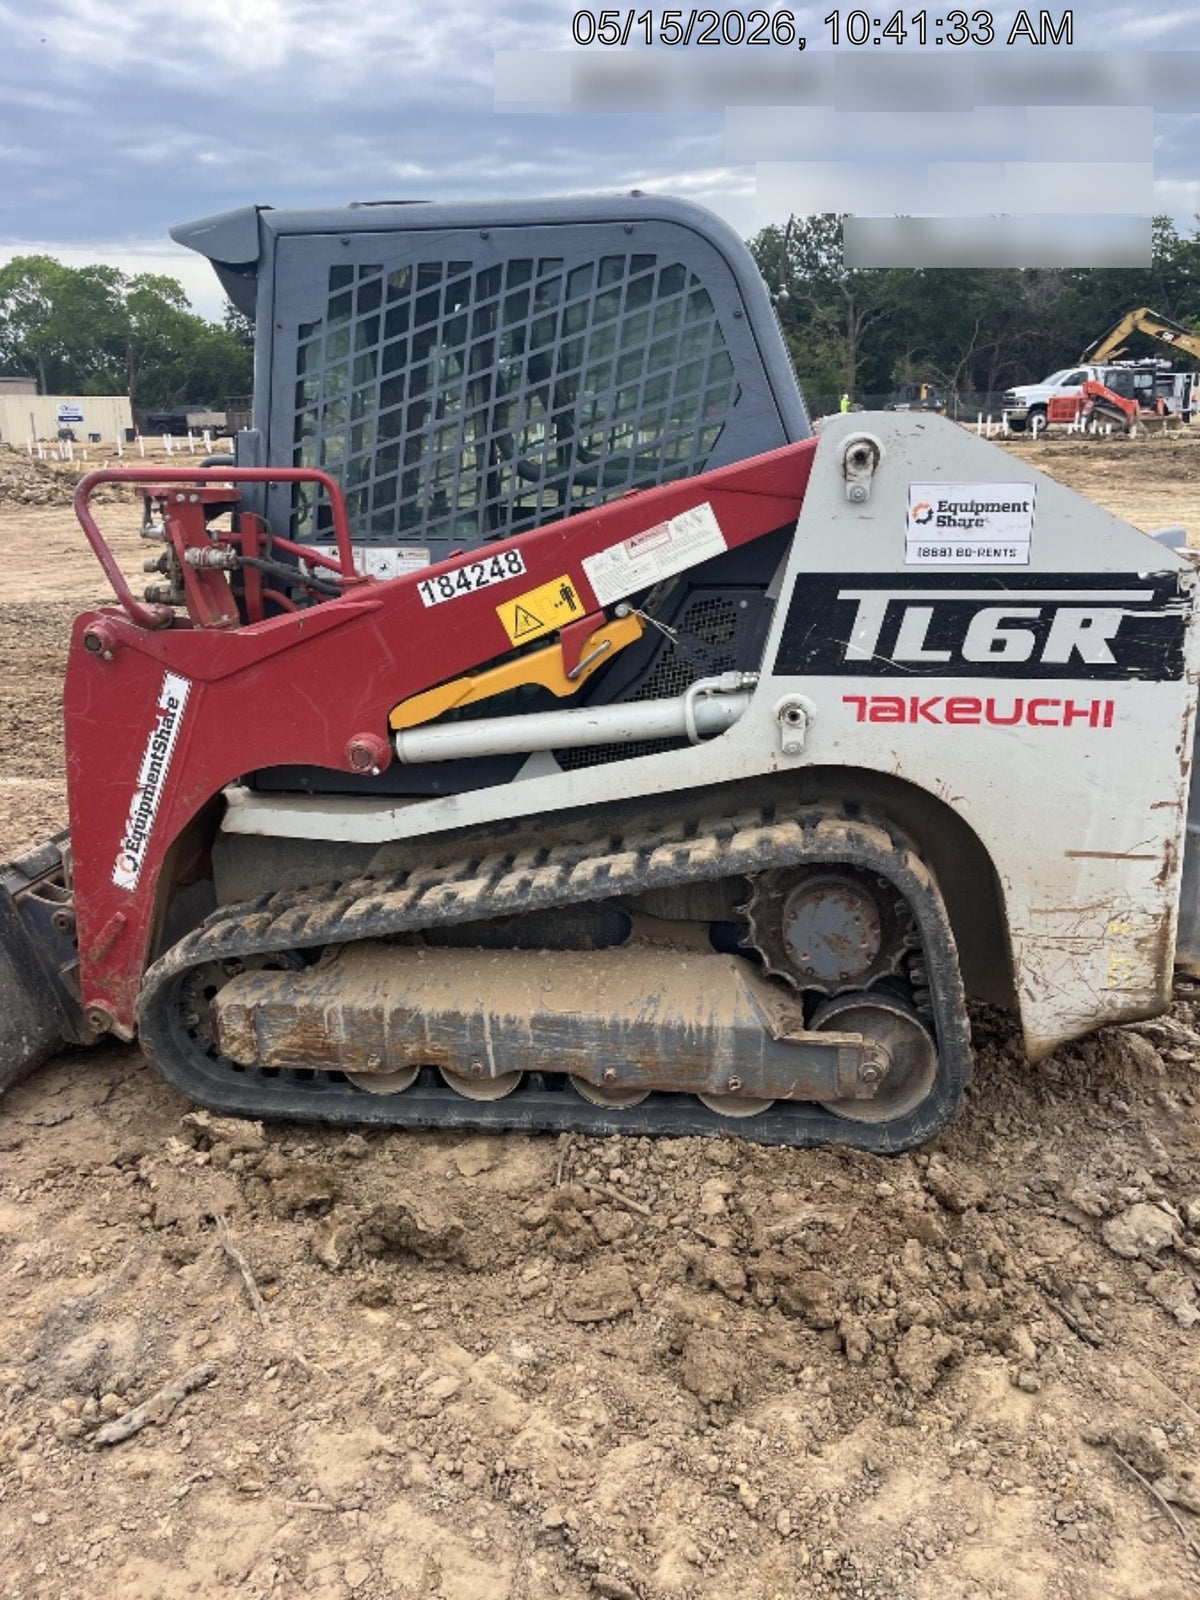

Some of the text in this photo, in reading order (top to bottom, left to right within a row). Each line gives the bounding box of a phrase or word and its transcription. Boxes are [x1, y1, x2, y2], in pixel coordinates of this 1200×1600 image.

[935, 515, 985, 529] Share
[936, 500, 1030, 516] Equipment
[421, 550, 522, 603] 184248
[837, 589, 1155, 664] TL6R
[125, 696, 179, 854] EquipmentShare
